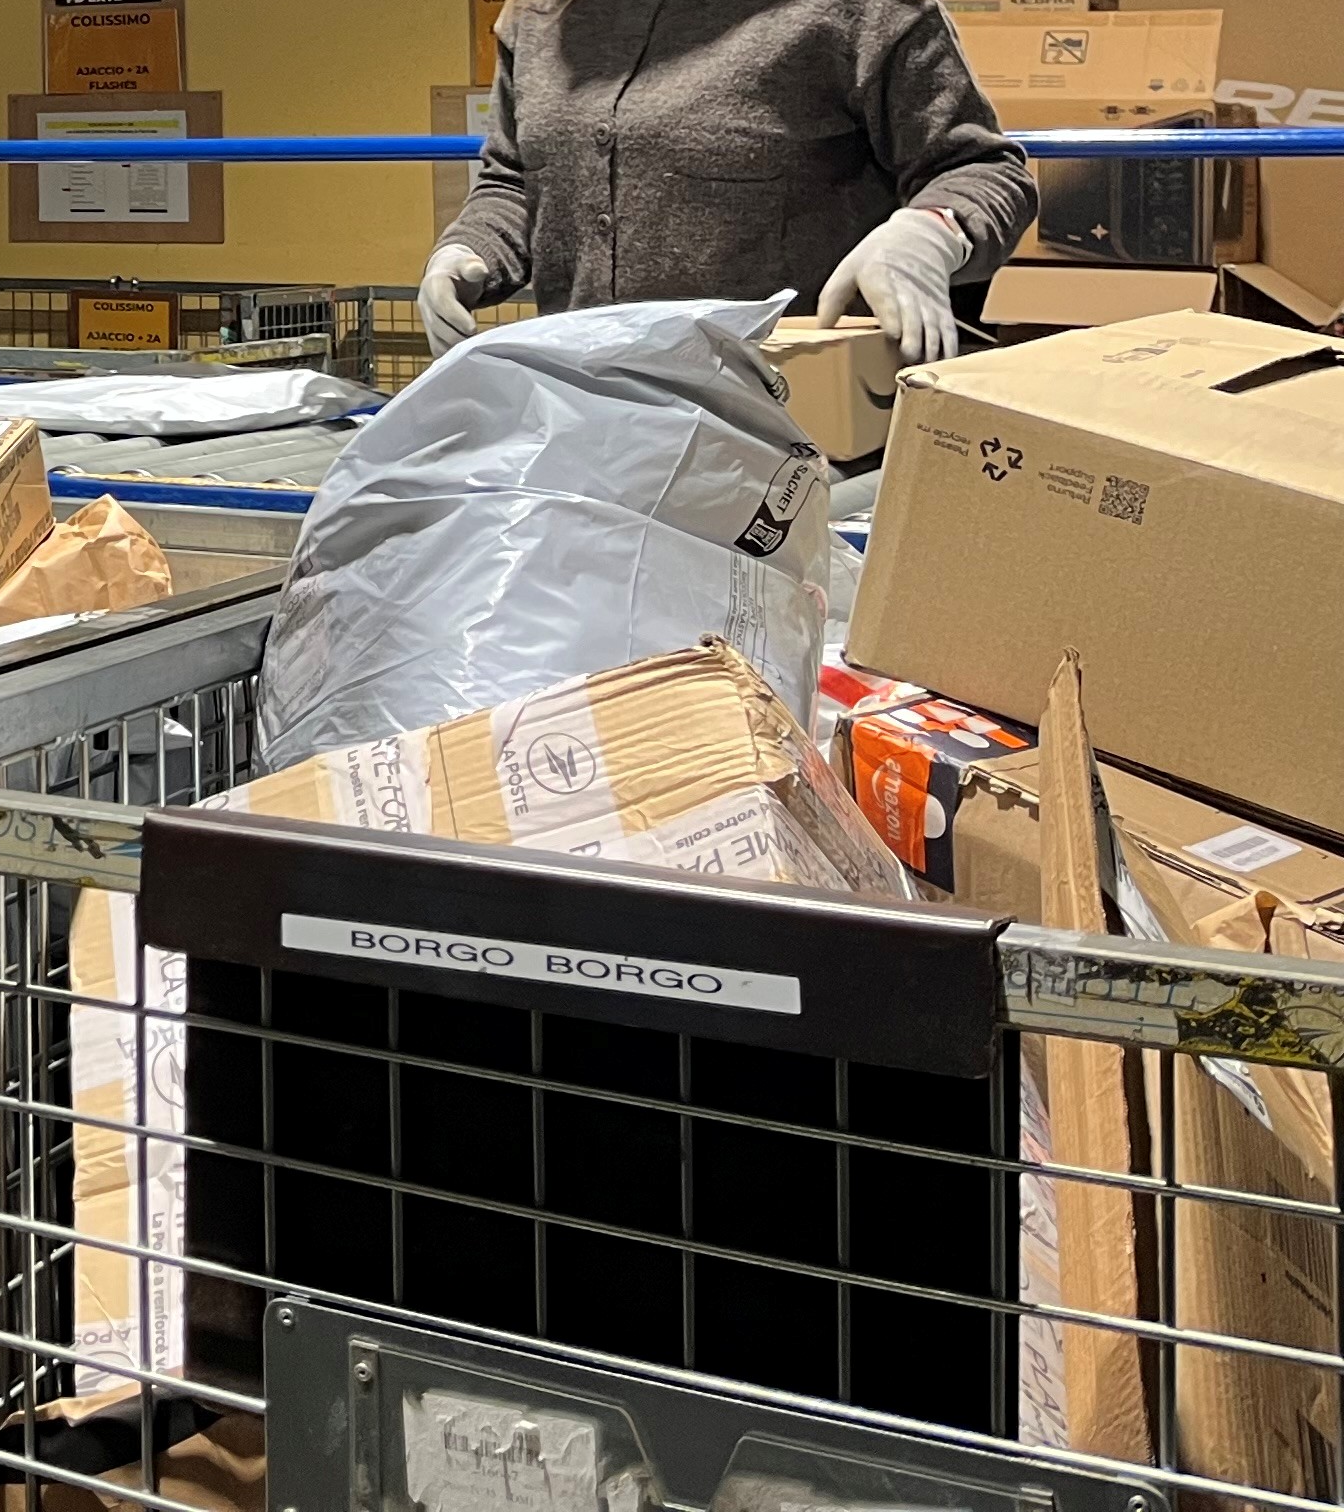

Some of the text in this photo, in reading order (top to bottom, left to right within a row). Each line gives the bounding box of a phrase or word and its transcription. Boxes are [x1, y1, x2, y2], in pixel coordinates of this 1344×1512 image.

[70, 13, 151, 28] COLISSIMO
[75, 66, 125, 76] AJACCIO
[135, 65, 150, 75] 2A
[93, 301, 155, 313] COLISSIMO
[86, 331, 135, 343] AJACCIO
[146, 333, 162, 344] 2A
[932, 426, 972, 445] recycle
[933, 439, 970, 457] Please
[776, 463, 810, 515] SACHET
[1048, 463, 1096, 484] Support
[502, 762, 530, 816] POSTE
[884, 756, 903, 841] amazon
[675, 806, 759, 851] votre colis
[349, 929, 723, 994] BORGO BORGO
[152, 1231, 166, 1274] Poe
[153, 1288, 169, 1355] renforcé
